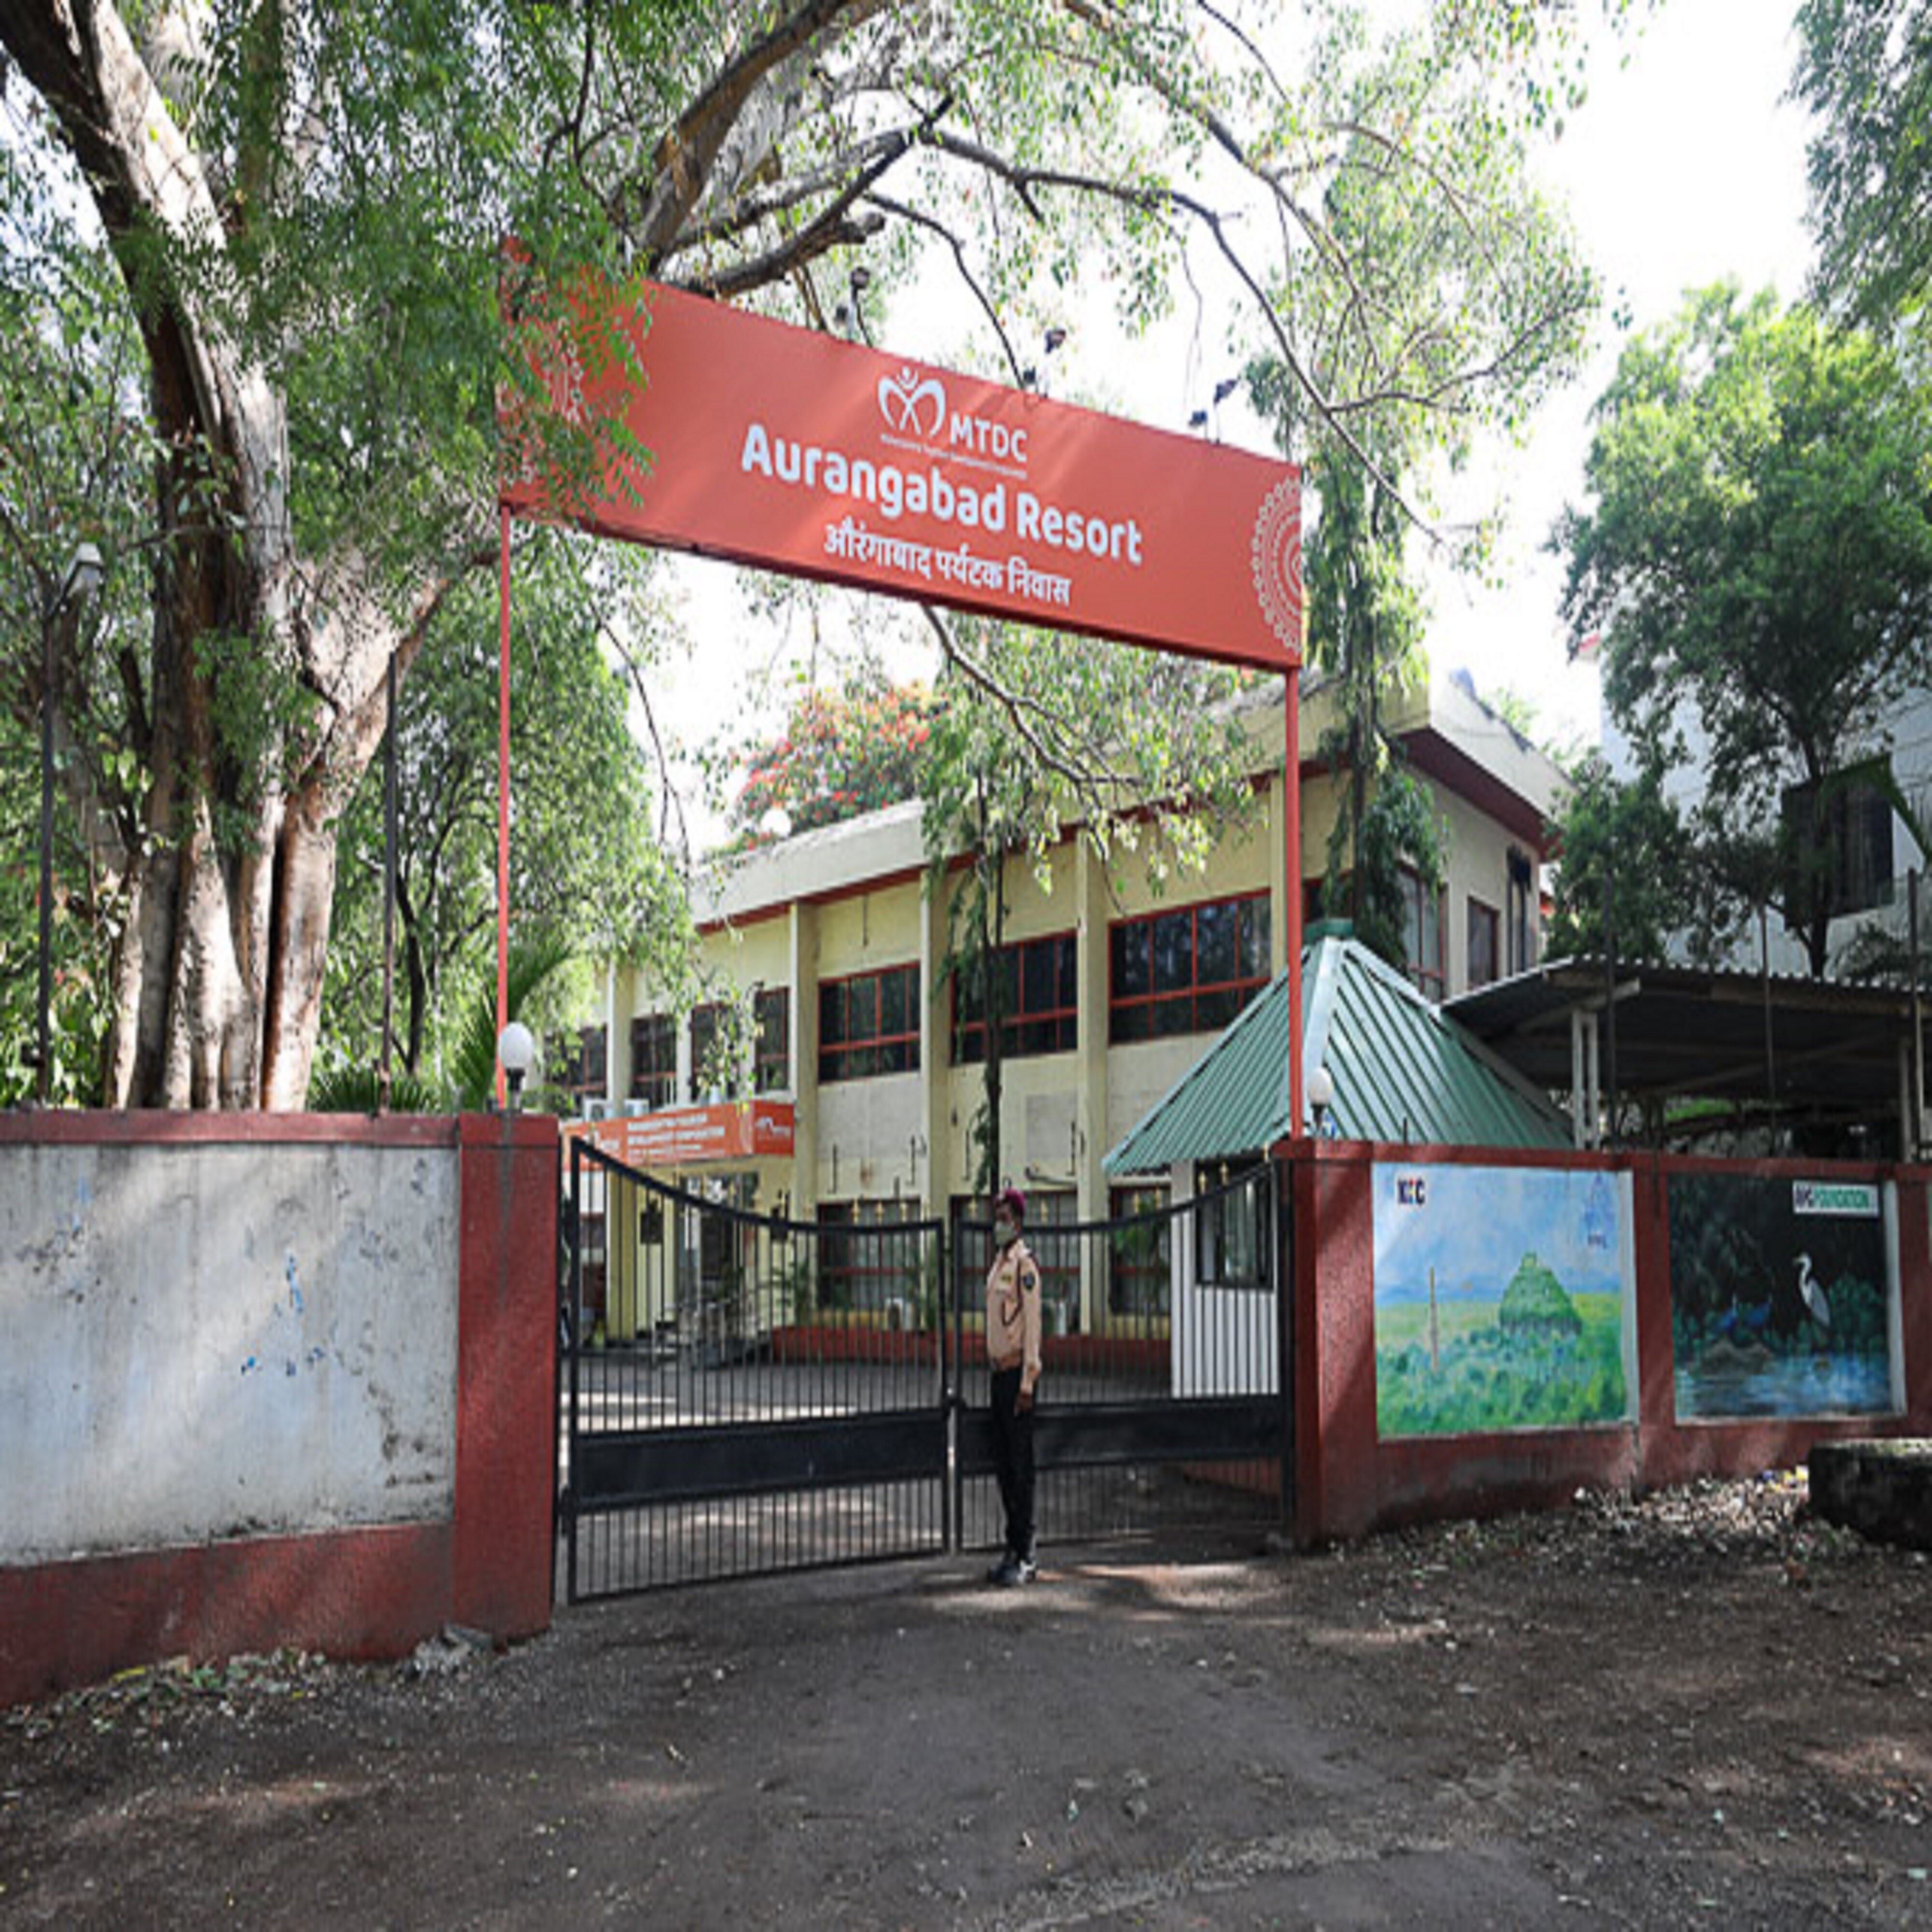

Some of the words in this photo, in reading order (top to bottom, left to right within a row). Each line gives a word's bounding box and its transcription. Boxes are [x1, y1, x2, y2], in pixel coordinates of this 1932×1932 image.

[950, 412, 1027, 463] MTDC
[741, 424, 1006, 531] Aurangabad
[1017, 492, 1142, 564] Resort
[824, 516, 932, 580] औरंगाबाद
[935, 543, 1003, 589] पर्यटक
[1007, 556, 1071, 605] निवास
